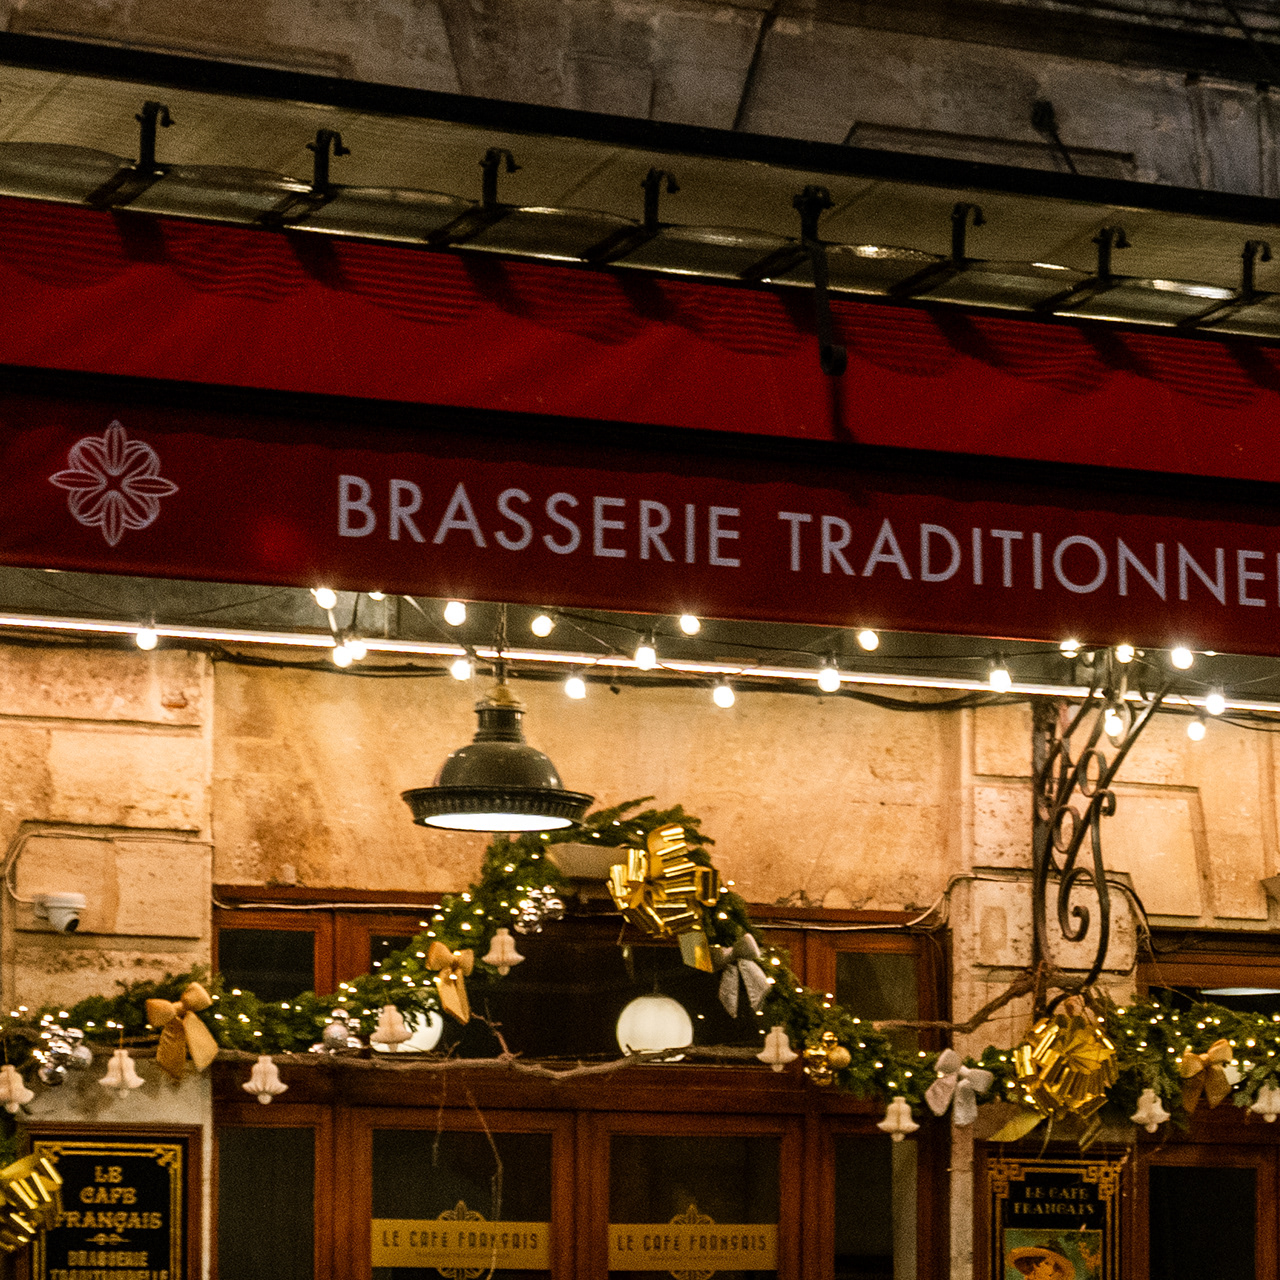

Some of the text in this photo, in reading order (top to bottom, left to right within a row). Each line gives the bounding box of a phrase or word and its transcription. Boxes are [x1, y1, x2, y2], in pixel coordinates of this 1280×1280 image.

[336, 474, 743, 569] BRASSERIE
[94, 1165, 123, 1183] LE
[1025, 1186, 1046, 1199] LE
[55, 1211, 163, 1233] FRANÇAIS
[382, 1230, 400, 1248] LE
[617, 1235, 634, 1252] LE
